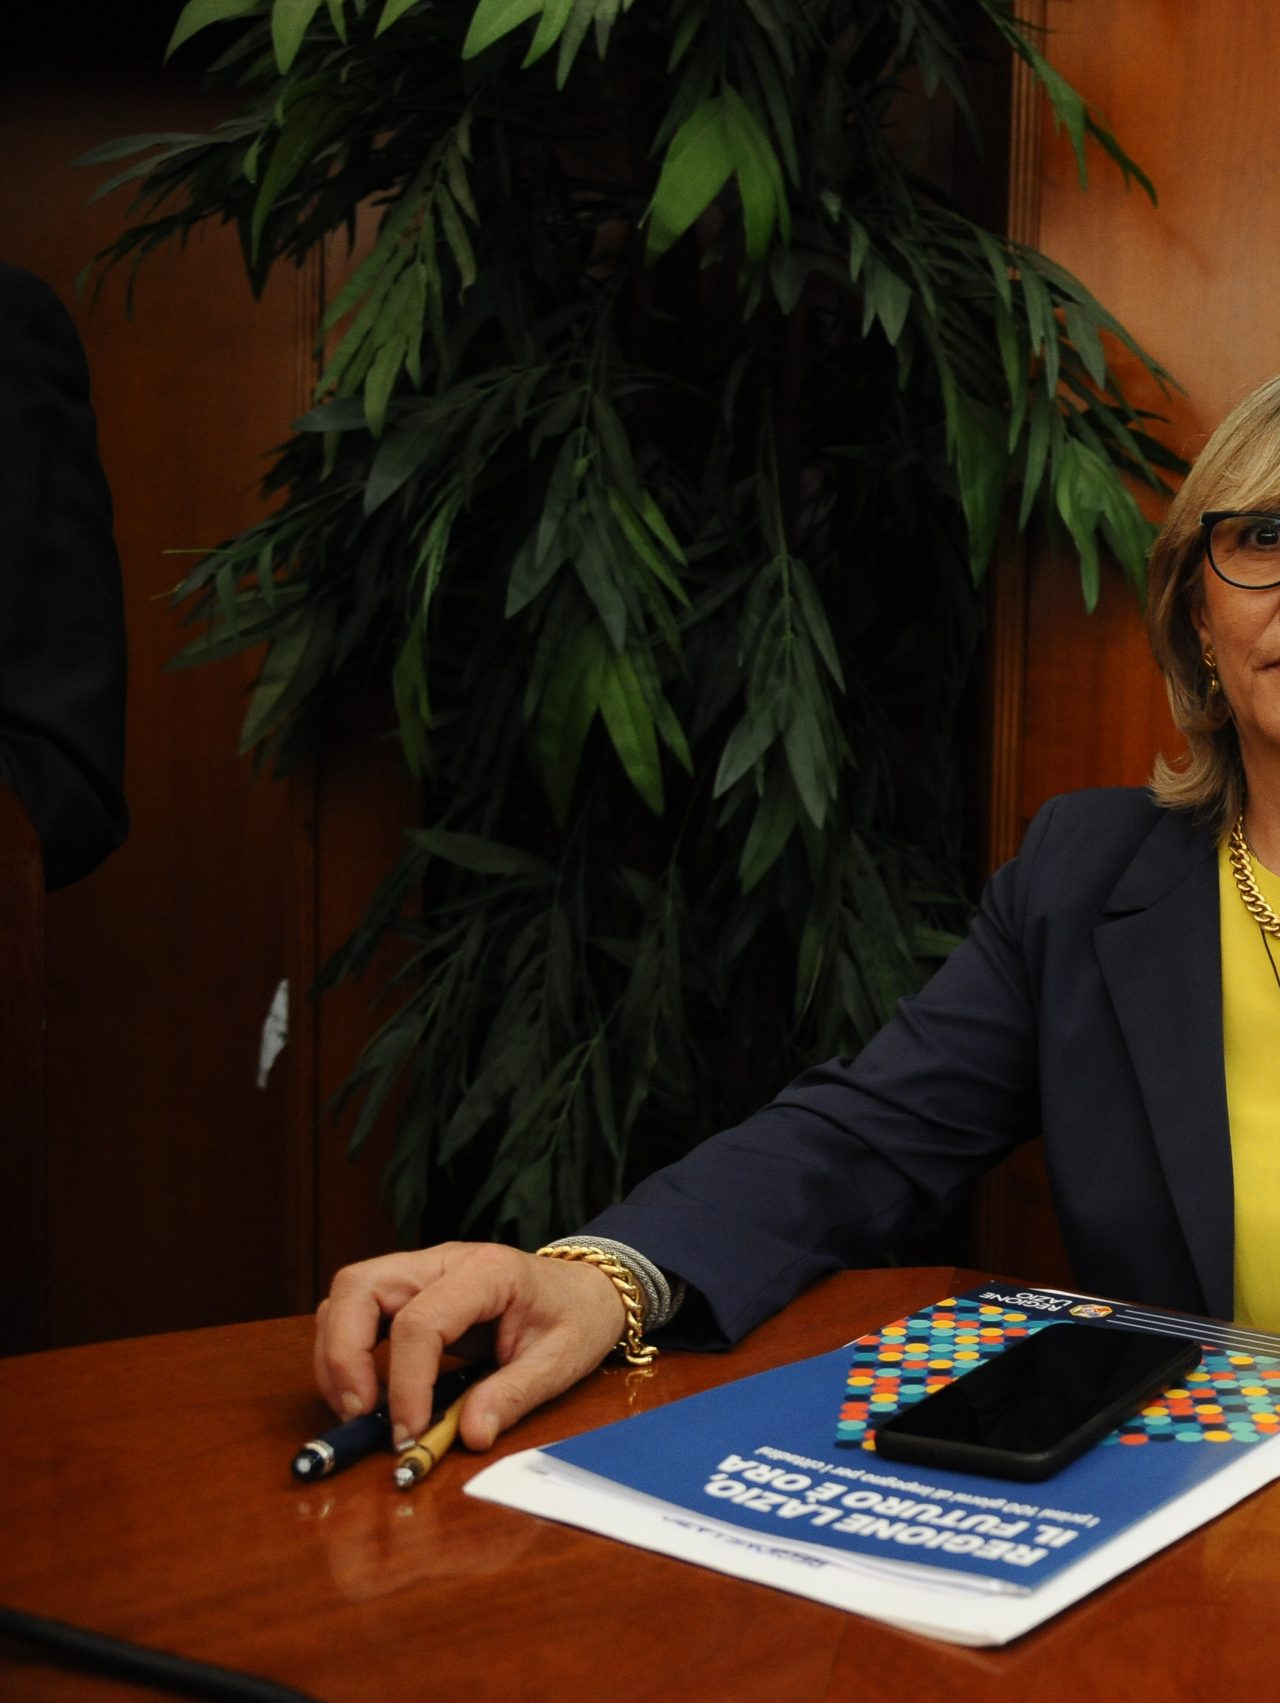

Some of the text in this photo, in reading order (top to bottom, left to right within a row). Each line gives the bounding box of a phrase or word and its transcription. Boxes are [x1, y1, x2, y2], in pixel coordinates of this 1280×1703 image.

[979, 1291, 1063, 1312] REGIONE
[1015, 1292, 1073, 1307] LAZIO
[703, 1473, 844, 1528] LAZIO,
[717, 1454, 1080, 1549] IL FUTURO È ORA
[831, 1511, 1050, 1568] REGIONE
